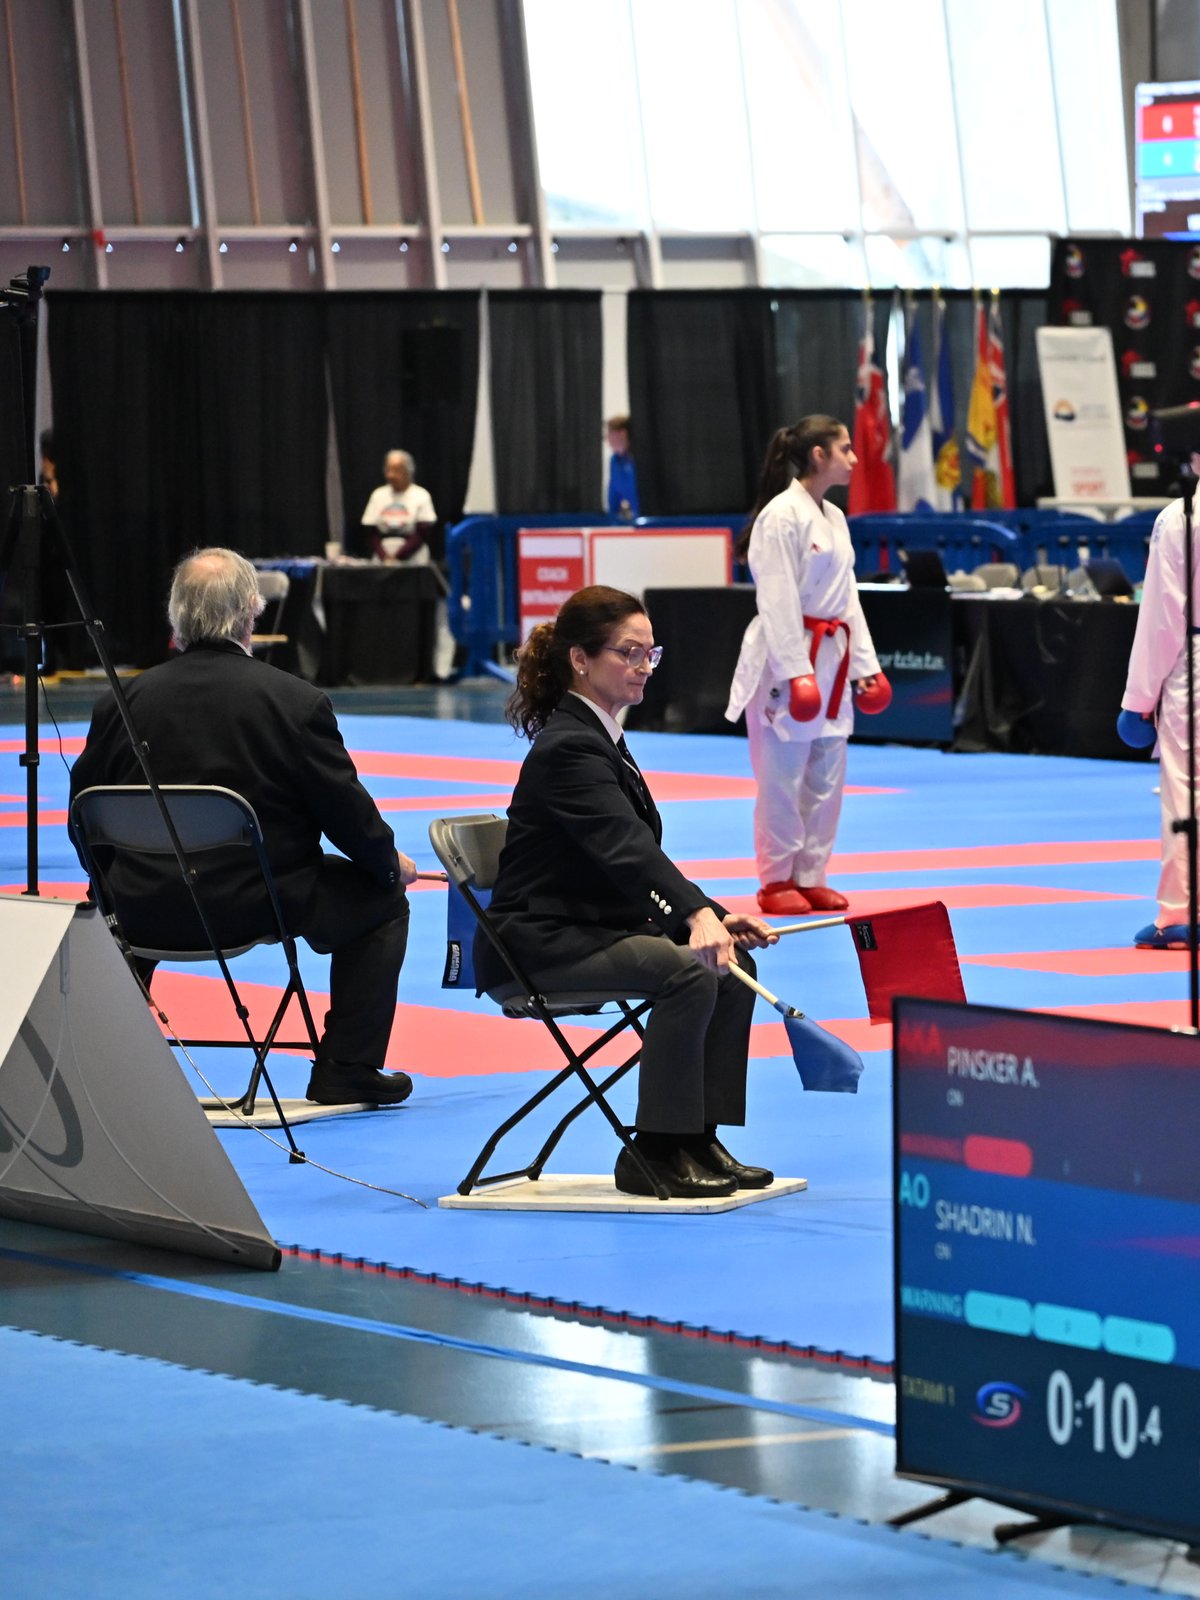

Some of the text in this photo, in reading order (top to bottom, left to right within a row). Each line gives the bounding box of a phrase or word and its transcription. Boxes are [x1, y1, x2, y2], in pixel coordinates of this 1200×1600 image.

[947, 1046, 1019, 1086] PINSKER
[899, 1170, 930, 1209] AO
[935, 1199, 1013, 1242] SHADRIN
